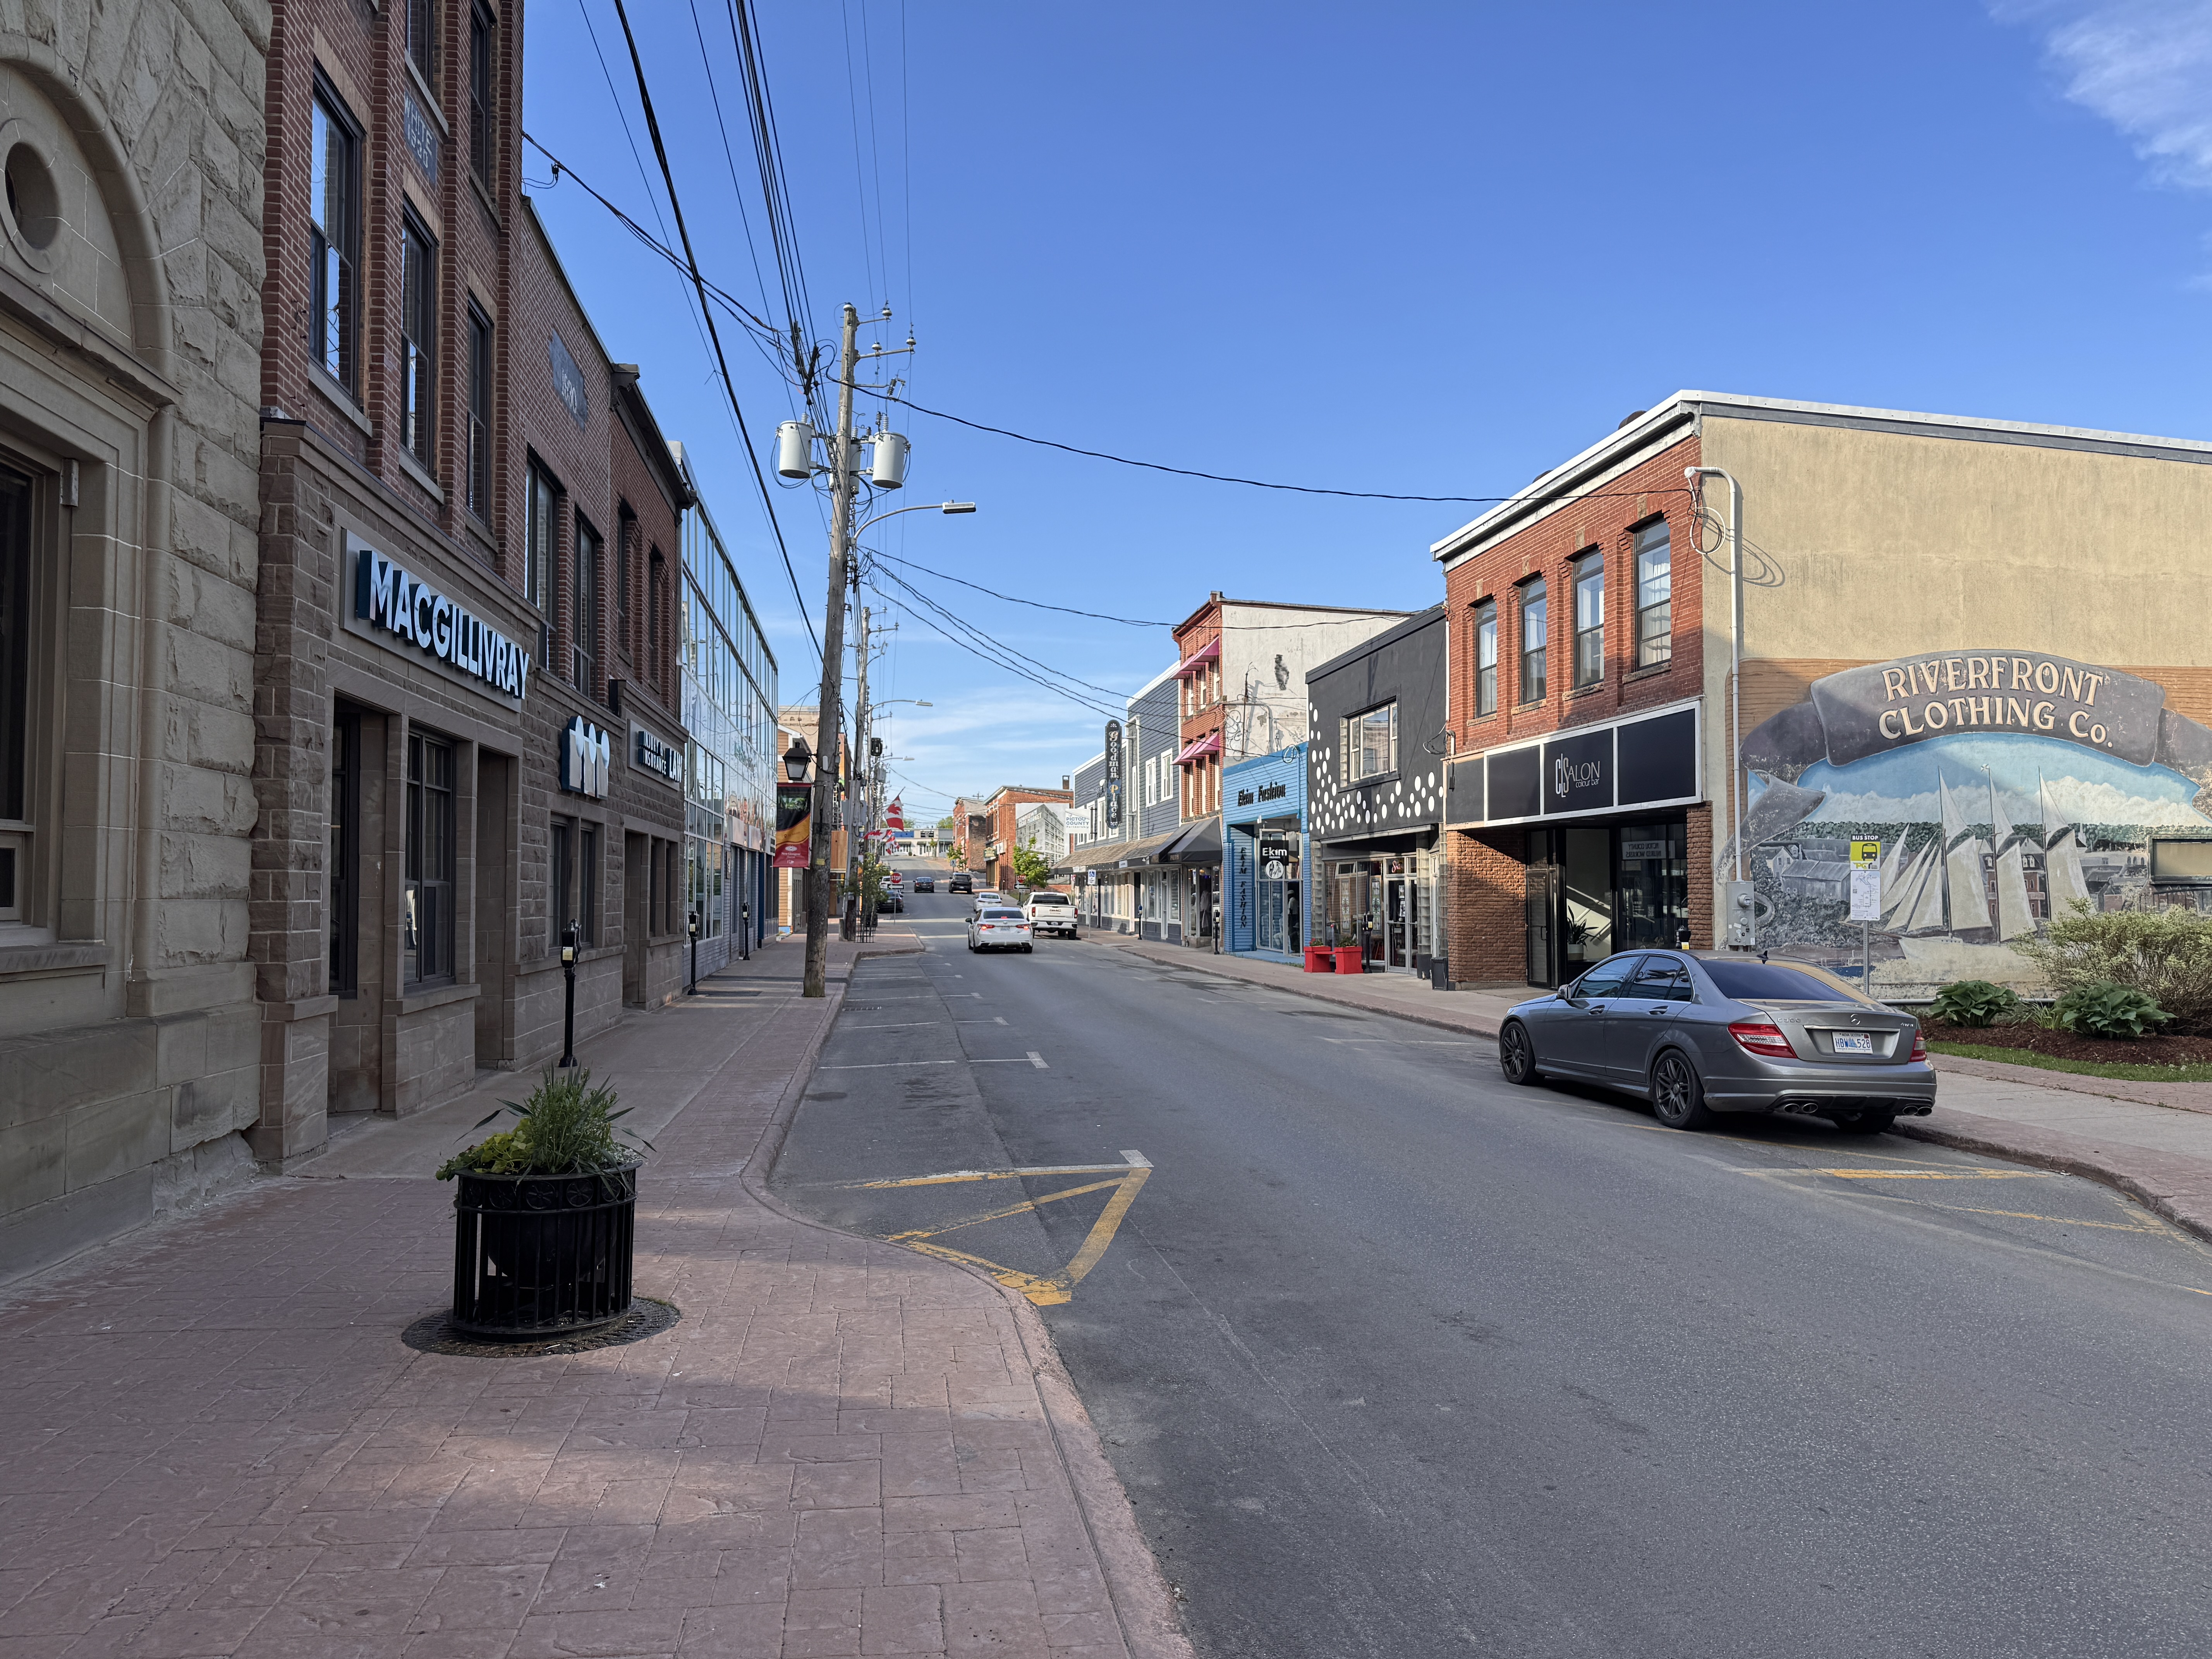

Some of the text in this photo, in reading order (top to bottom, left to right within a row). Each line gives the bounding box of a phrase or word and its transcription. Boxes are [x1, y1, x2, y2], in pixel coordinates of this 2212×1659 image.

[404, 91, 433, 156] WHITE
[369, 550, 530, 700] MACGILLIVRAY
[1881, 656, 2104, 706] RIVERFRONT
[1879, 696, 2113, 747] CLOTHING Co.
[644, 731, 659, 754] INJURY
[643, 748, 666, 775] INSURANCE
[669, 748, 683, 783] LAW
[1238, 781, 1286, 806] Ekim Fashion
[1575, 779, 1590, 788] colour
[1109, 784, 1118, 818] Place
[1262, 847, 1287, 856] Ekim
[1835, 1038, 1870, 1048] HBW 528
